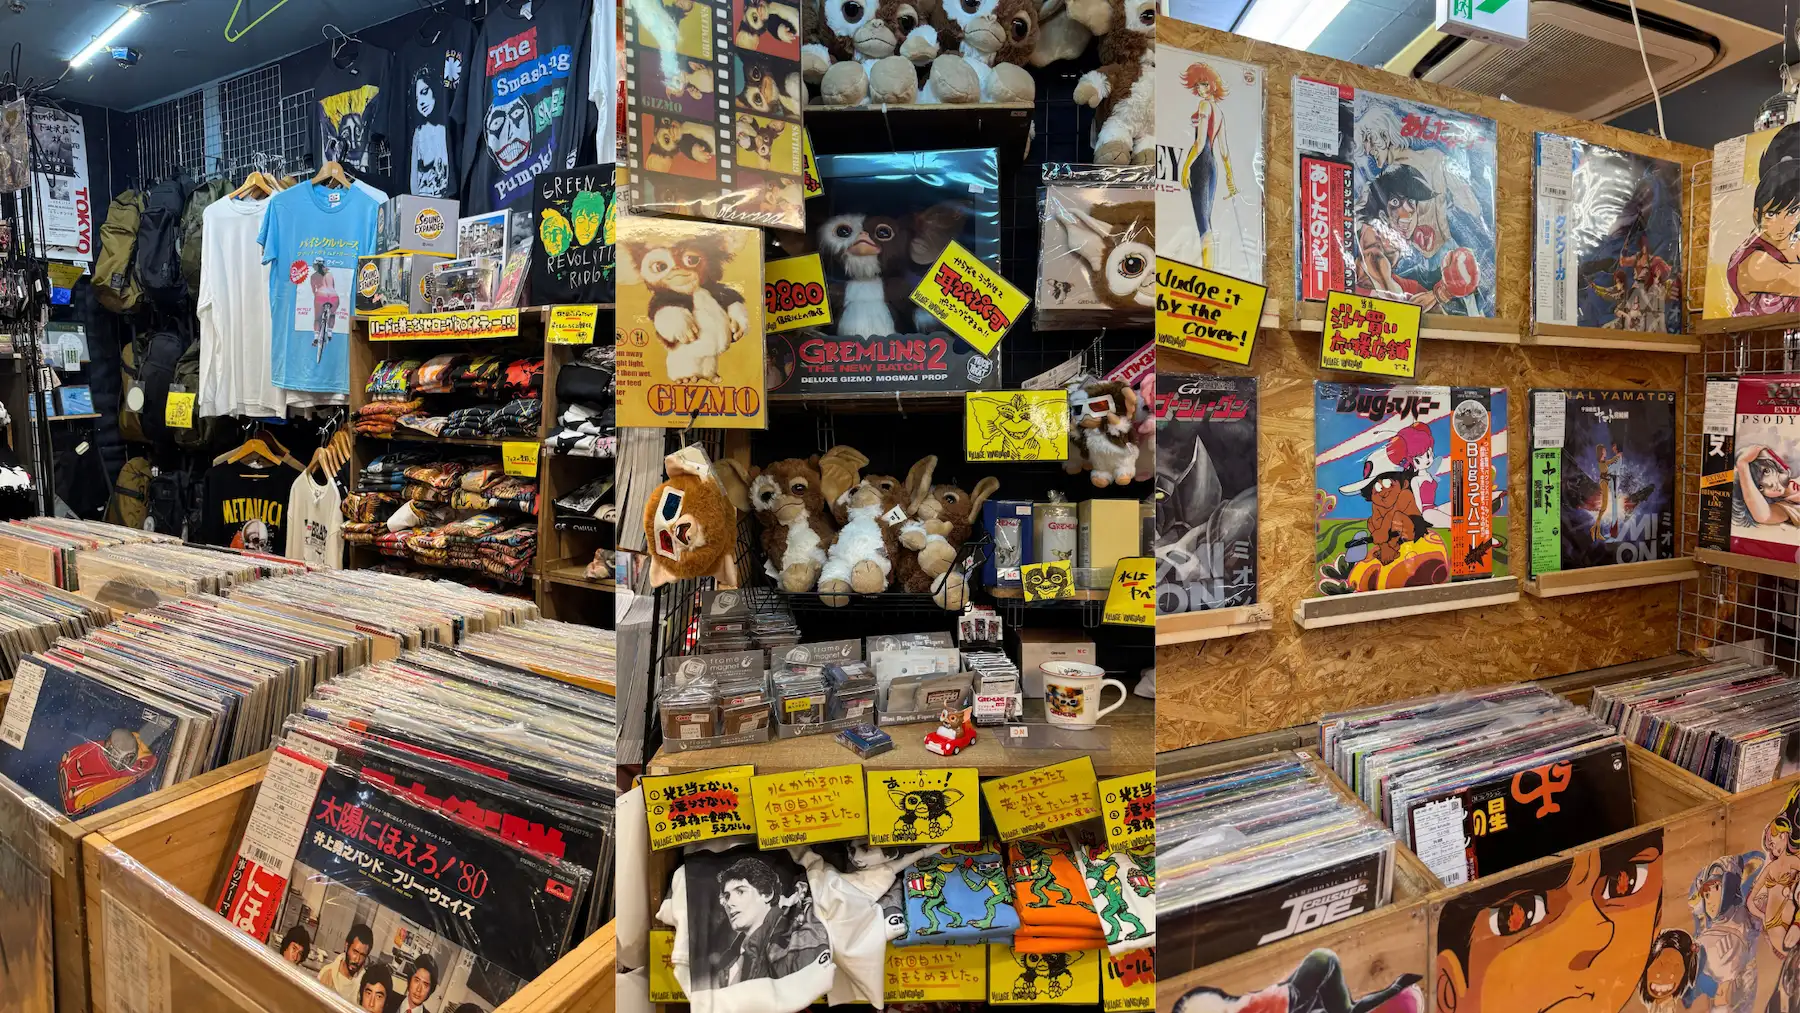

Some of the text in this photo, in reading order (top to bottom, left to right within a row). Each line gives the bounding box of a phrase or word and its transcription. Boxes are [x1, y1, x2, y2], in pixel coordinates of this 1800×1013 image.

[489, 38, 532, 69] The
[641, 96, 683, 113] GIZMO
[543, 176, 595, 200] GREEN
[1343, 169, 1353, 218] オリジナル
[75, 187, 91, 255] TOKYO
[414, 222, 445, 234] EXPANDER
[418, 211, 441, 224] SOUND
[1309, 164, 1329, 291] あしたのジョー
[1156, 269, 1243, 306] Judge it
[1156, 295, 1222, 322] by the
[927, 337, 948, 371] 2
[801, 376, 838, 384] DELUXE
[840, 375, 873, 383] GIZMO
[808, 363, 924, 373] THE NEW BATCH
[647, 384, 760, 417] GIZMO
[1336, 389, 1440, 421] Bugってハニー
[1601, 392, 1667, 401] YAMATO
[1741, 415, 1797, 425] PSODY
[1465, 442, 1481, 549] Bugってハニー
[1616, 541, 1658, 565] ON
[1155, 578, 1226, 615] ON
[813, 645, 840, 653] frame
[709, 663, 740, 672] magnet
[766, 807, 861, 831] あきらめました。
[1472, 797, 1509, 837] の星
[316, 796, 456, 880] 太陽にほえろ!
[1302, 883, 1368, 911] CRUSHER
[888, 969, 980, 985] あきらめました。
